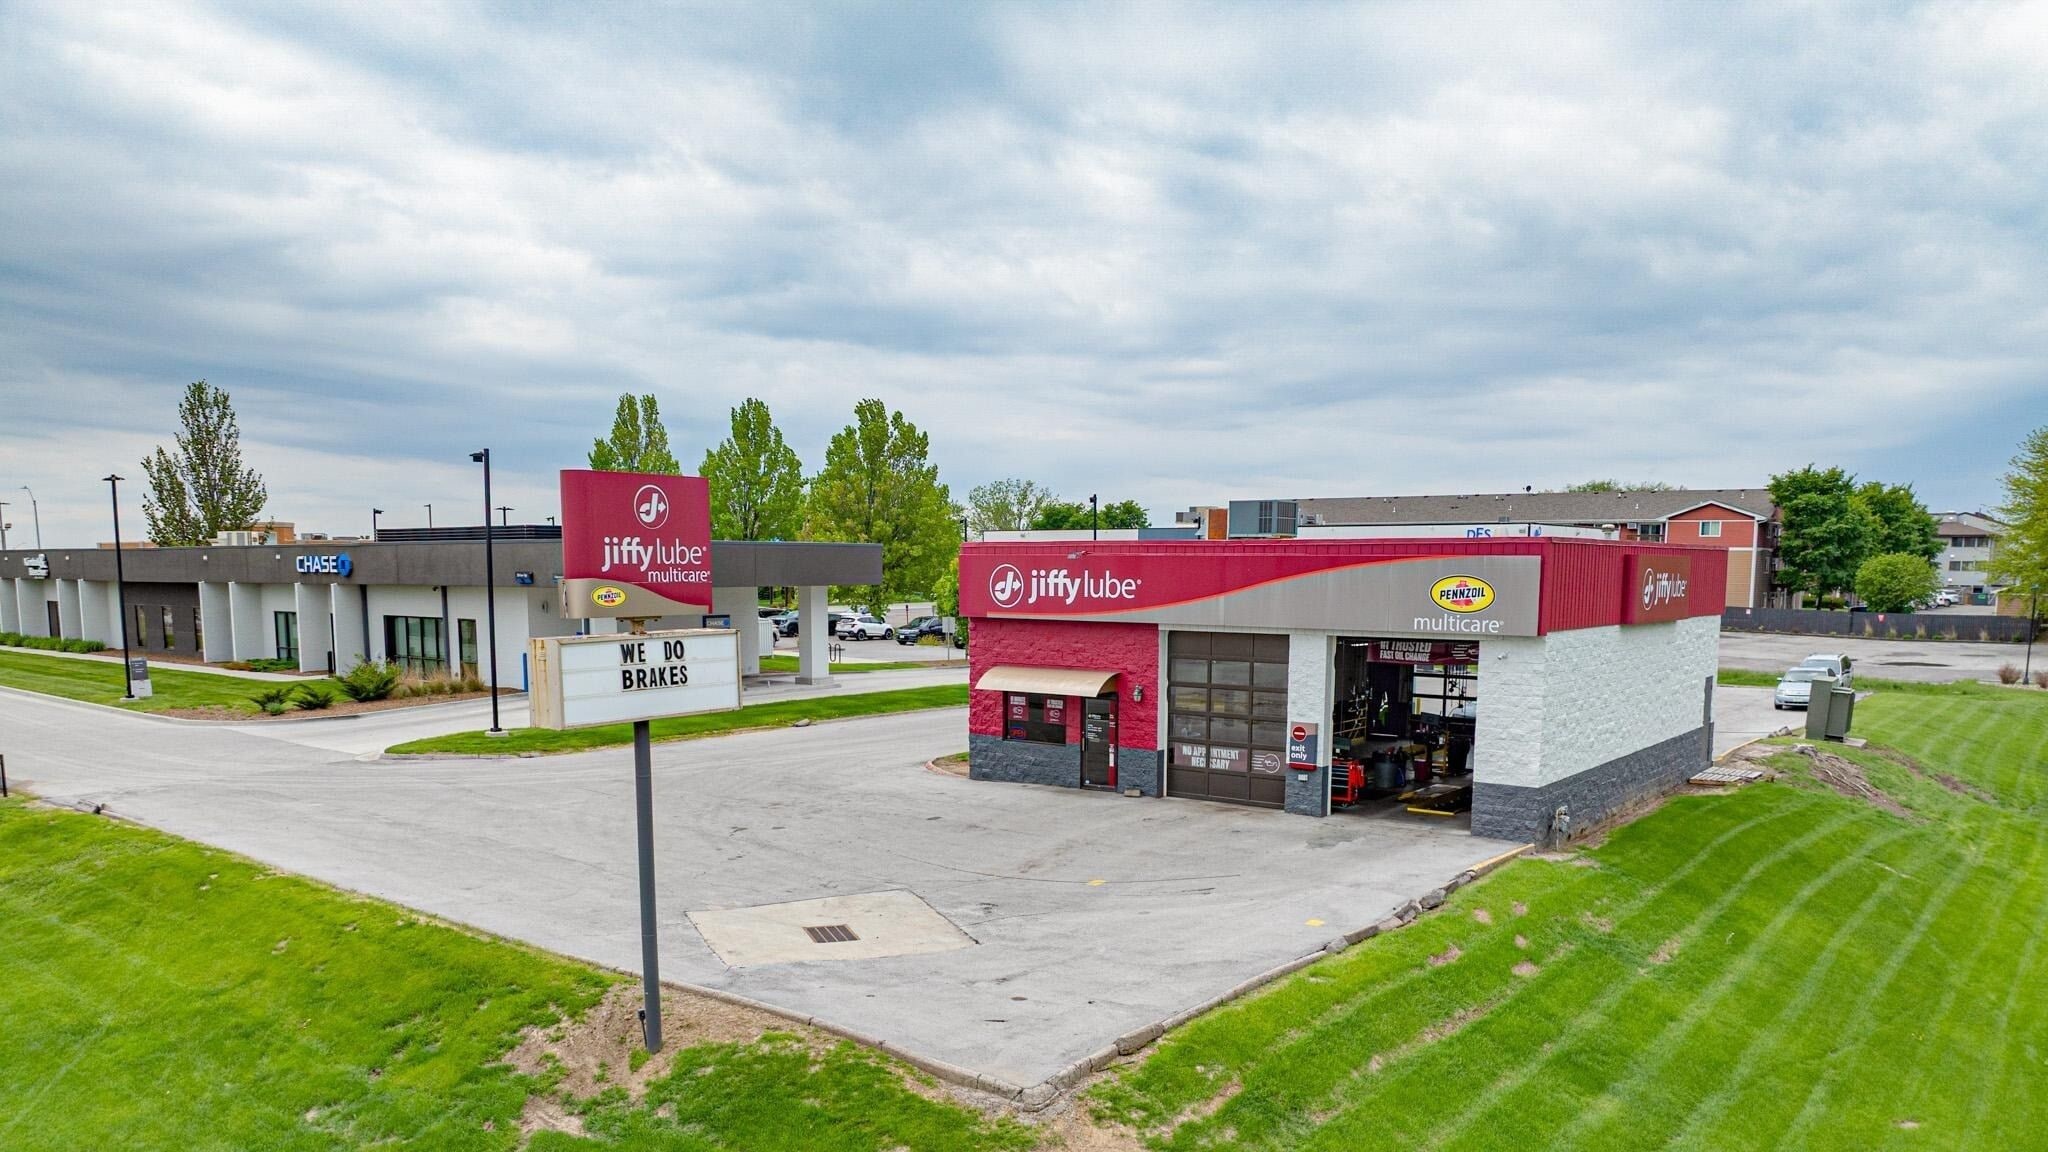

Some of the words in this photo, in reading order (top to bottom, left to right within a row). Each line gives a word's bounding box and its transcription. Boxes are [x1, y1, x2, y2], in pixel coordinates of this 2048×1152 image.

[296, 555, 338, 573] CHASE
[648, 567, 708, 582] multicare
[1440, 587, 1486, 600] PENNZOIL
[1414, 613, 1500, 633] multicare
[620, 642, 646, 664] WE
[664, 640, 685, 660] DO
[1380, 650, 1394, 660] FAST
[1405, 652, 1431, 662] CHANGE
[622, 665, 688, 690] BRAKES
[1182, 745, 1192, 756] NO
[1291, 744, 1305, 752] exit
[1291, 751, 1307, 761] only
